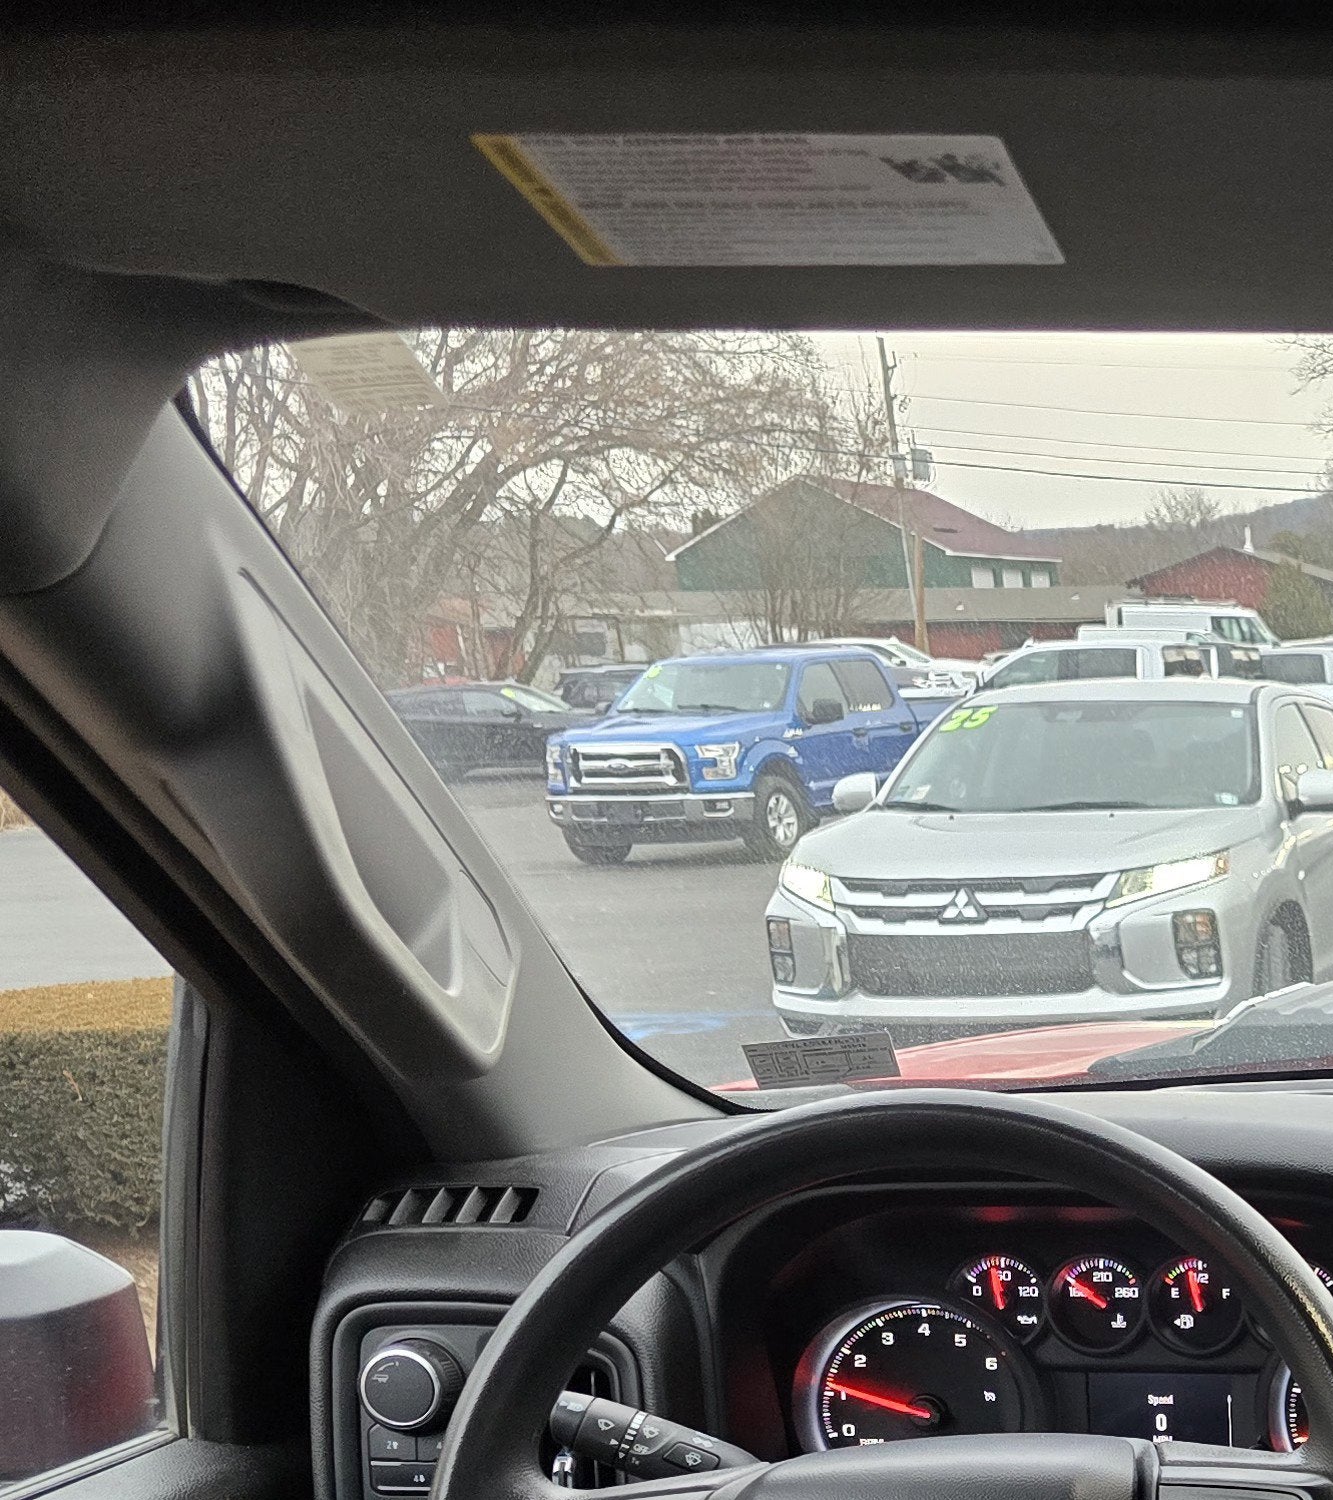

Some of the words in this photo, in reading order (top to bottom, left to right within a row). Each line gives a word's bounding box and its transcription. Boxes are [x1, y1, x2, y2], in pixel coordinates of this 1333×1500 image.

[939, 705, 999, 733] 25
[1093, 1271, 1113, 1283] 210
[973, 1286, 982, 1298] 0
[1018, 1286, 1039, 1298] 120
[1115, 1286, 1139, 1299] 260
[1171, 1287, 1180, 1299] E
[1222, 1288, 1231, 1300] F
[918, 1323, 931, 1337] 4
[882, 1332, 895, 1346] 3
[954, 1333, 967, 1347] 5
[854, 1355, 867, 1368] 2
[985, 1357, 998, 1371] 6
[1147, 1394, 1174, 1405] Speed
[1155, 1413, 1168, 1431] 0
[842, 1423, 856, 1437] 0
